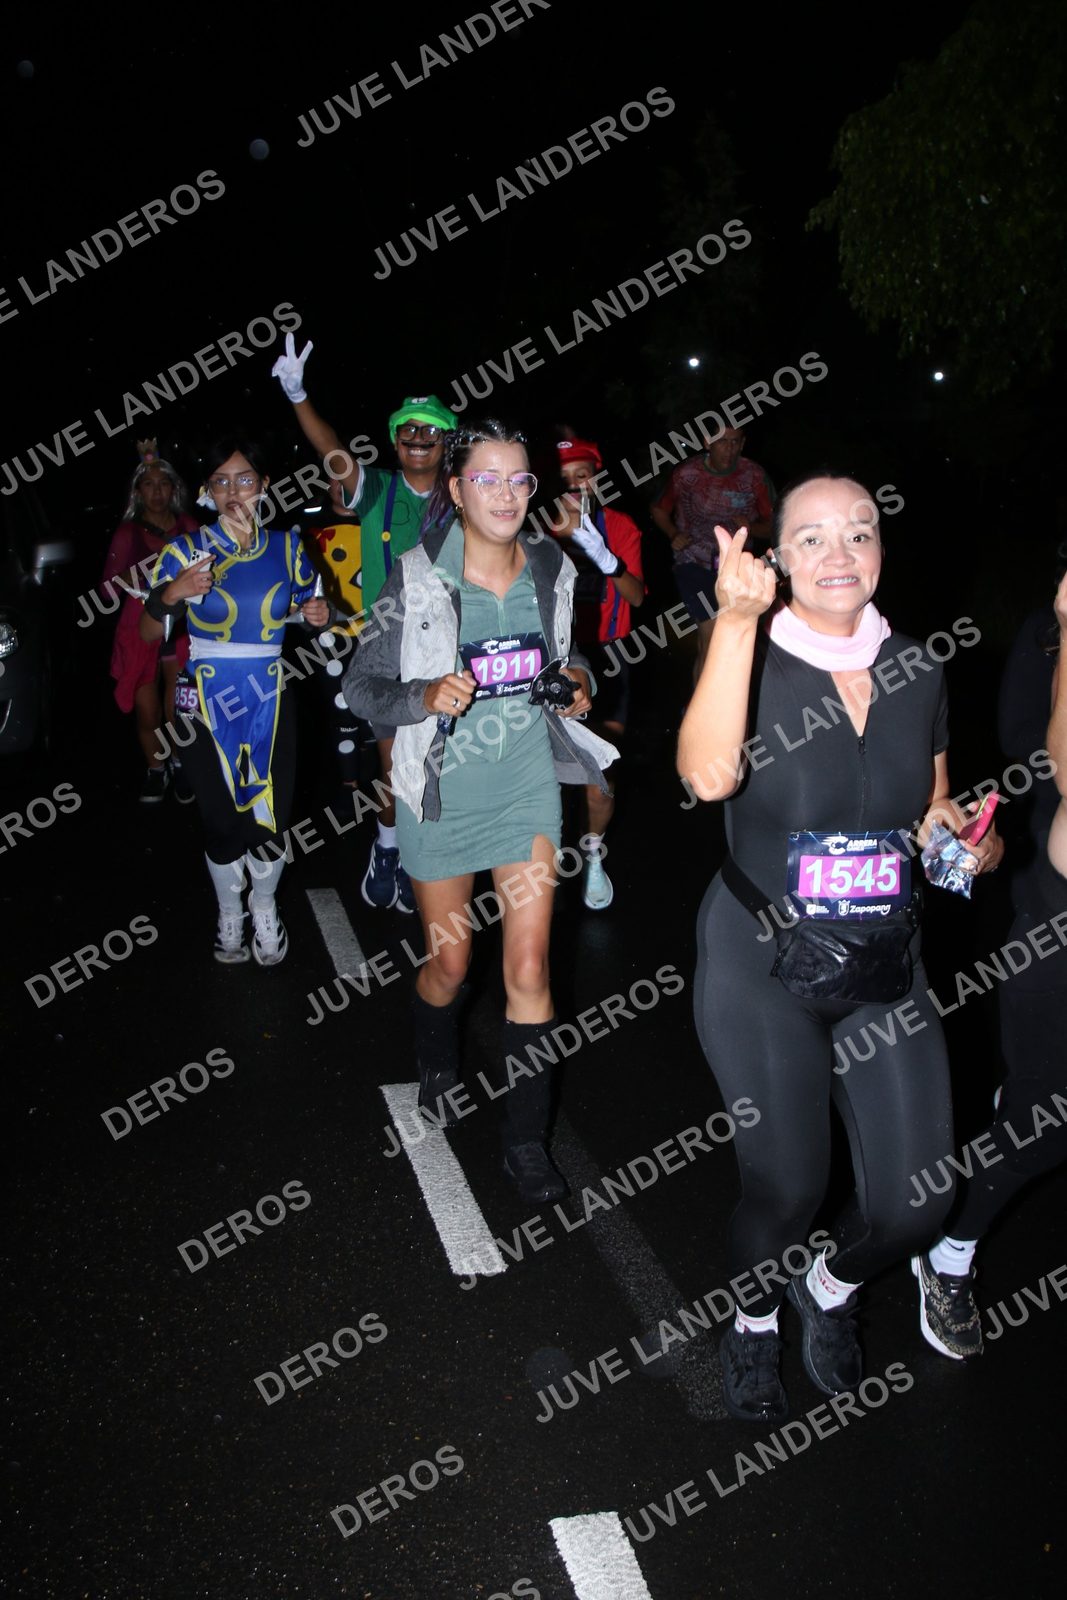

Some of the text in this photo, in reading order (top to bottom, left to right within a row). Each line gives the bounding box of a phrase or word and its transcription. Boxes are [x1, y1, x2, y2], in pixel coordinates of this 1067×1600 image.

[477, 651, 536, 684] 1911
[805, 856, 897, 894] 1545
[850, 903, 892, 916] Zapopan
